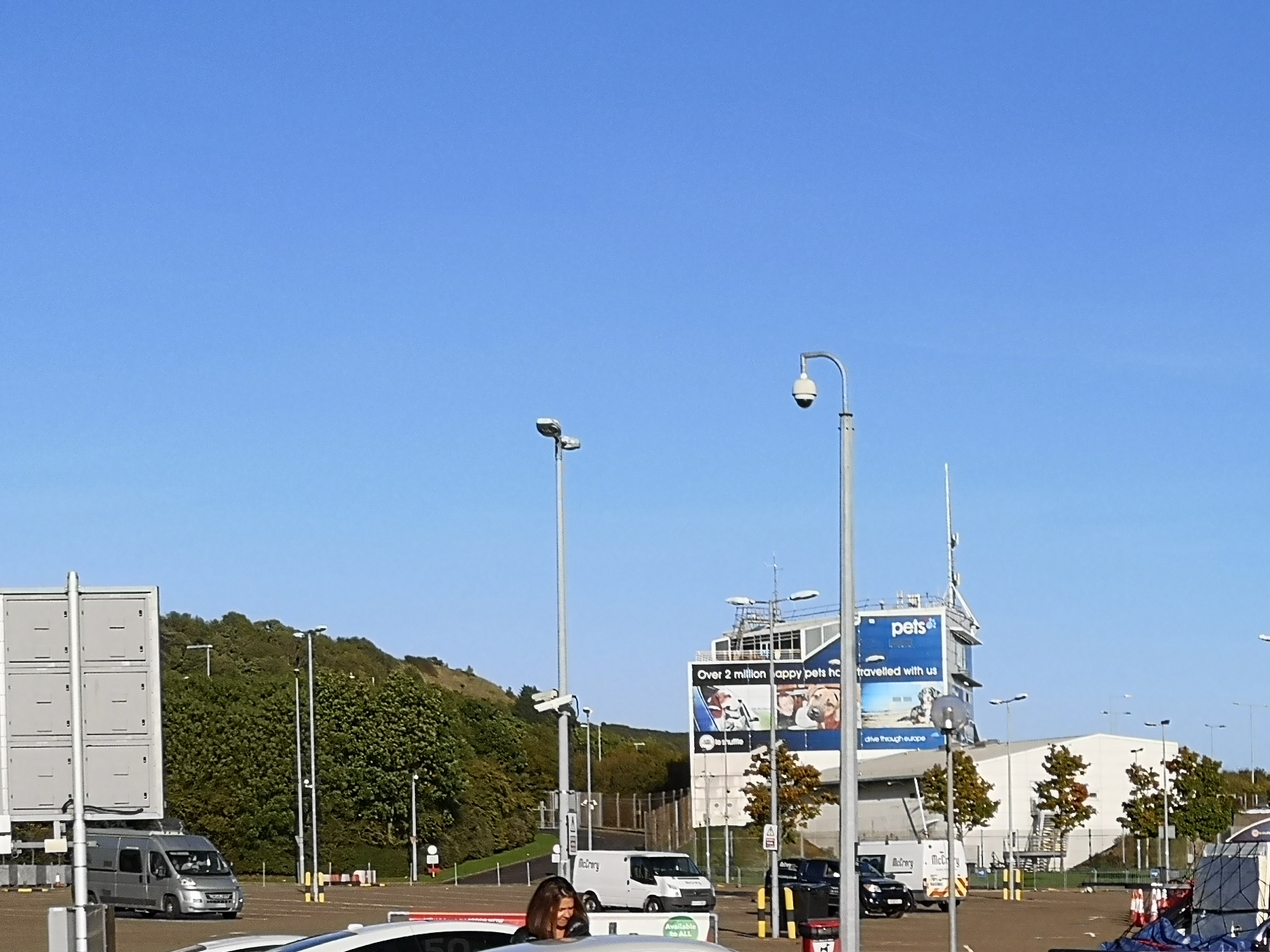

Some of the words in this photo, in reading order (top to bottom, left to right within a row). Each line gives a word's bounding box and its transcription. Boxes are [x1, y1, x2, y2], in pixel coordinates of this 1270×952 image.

[891, 618, 927, 638] pets
[697, 669, 722, 680] Over
[724, 669, 731, 680] 2
[734, 668, 767, 680] million
[773, 669, 802, 682] appy
[804, 667, 826, 681] pets
[856, 665, 901, 677] travelled
[903, 665, 924, 676] with
[926, 666, 938, 676] us
[864, 735, 880, 743] drive
[903, 735, 926, 743] europe
[931, 854, 960, 868] McCry
[664, 923, 697, 931] Available
[669, 930, 678, 938] to
[678, 930, 692, 938] ALL
